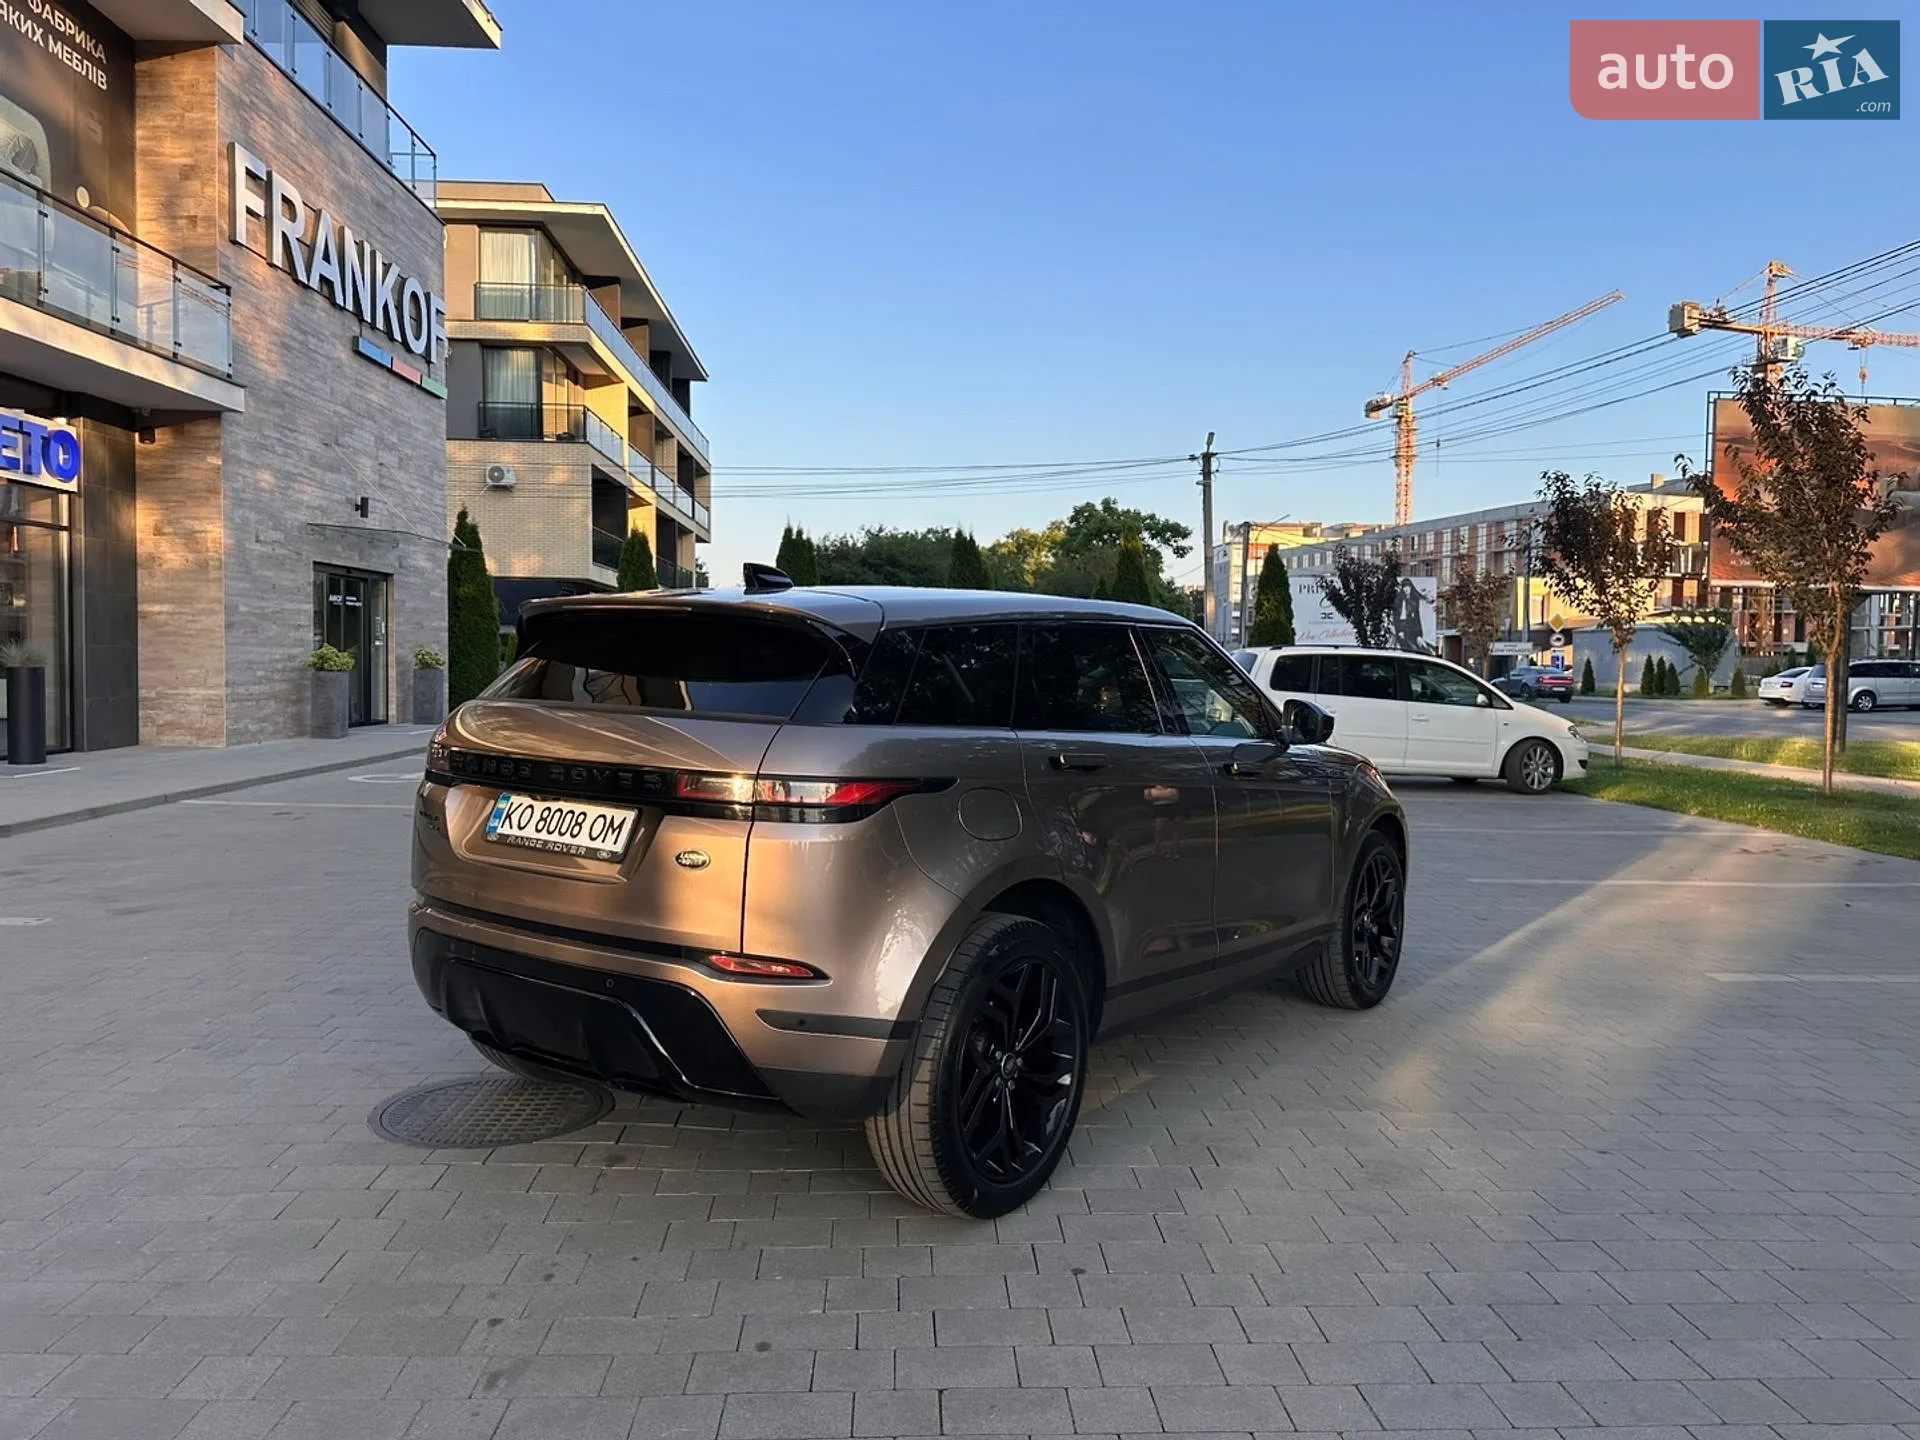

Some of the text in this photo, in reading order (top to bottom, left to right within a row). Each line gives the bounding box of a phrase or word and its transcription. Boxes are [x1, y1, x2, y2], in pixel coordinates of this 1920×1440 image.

[28, 0, 107, 64] ФАБРИКА
[48, 34, 107, 90] МЕБЛІВ
[228, 142, 446, 364] FRANKOF
[501, 802, 627, 845] KO 8008 OM
[506, 836, 586, 855] RANGE ROVER
